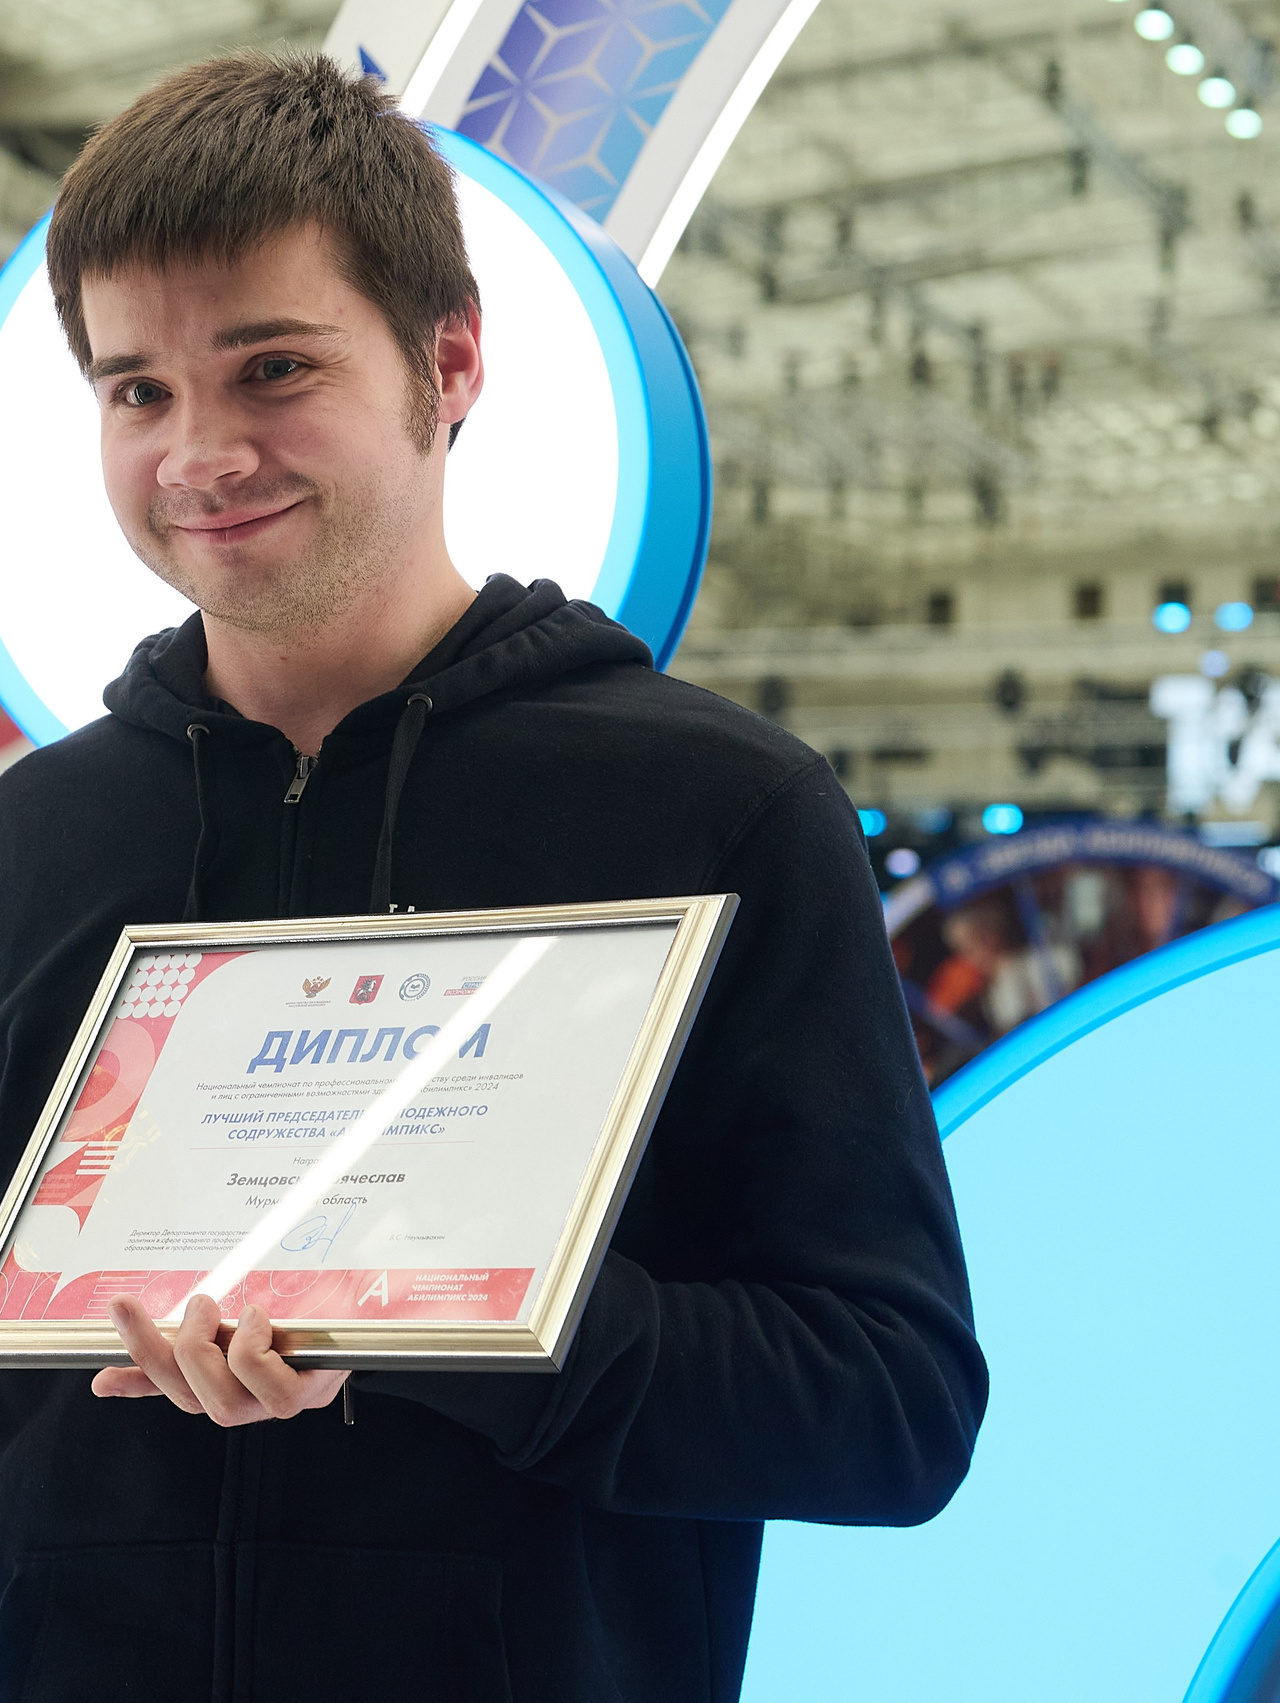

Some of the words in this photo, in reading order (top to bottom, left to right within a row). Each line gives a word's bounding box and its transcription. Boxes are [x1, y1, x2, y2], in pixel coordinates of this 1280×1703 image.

[196, 1082, 256, 1091] Национальный
[258, 1081, 300, 1089] чемпионат
[314, 1077, 397, 1090] профессиональном
[451, 1074, 476, 1083] среди
[478, 1072, 524, 1082] инвалидов
[218, 1093, 232, 1101] лиц
[241, 1091, 303, 1101] ограниченными
[306, 1088, 370, 1097] возможностями
[474, 1082, 499, 1091] 2024
[201, 1109, 264, 1124] ЛУЧШИЙ
[227, 1125, 325, 1141] СОДРУЖЕСТВА
[336, 1171, 406, 1185] ячеслав
[322, 1193, 368, 1205] область
[130, 1229, 161, 1237] Директор
[161, 1229, 206, 1237] Департамента
[414, 1272, 490, 1281] НАЦИОНАЛЬНЫЙ
[411, 1283, 464, 1291] ЧЕМПИОНАТ
[407, 1293, 467, 1301] АБИЛИМПИКС
